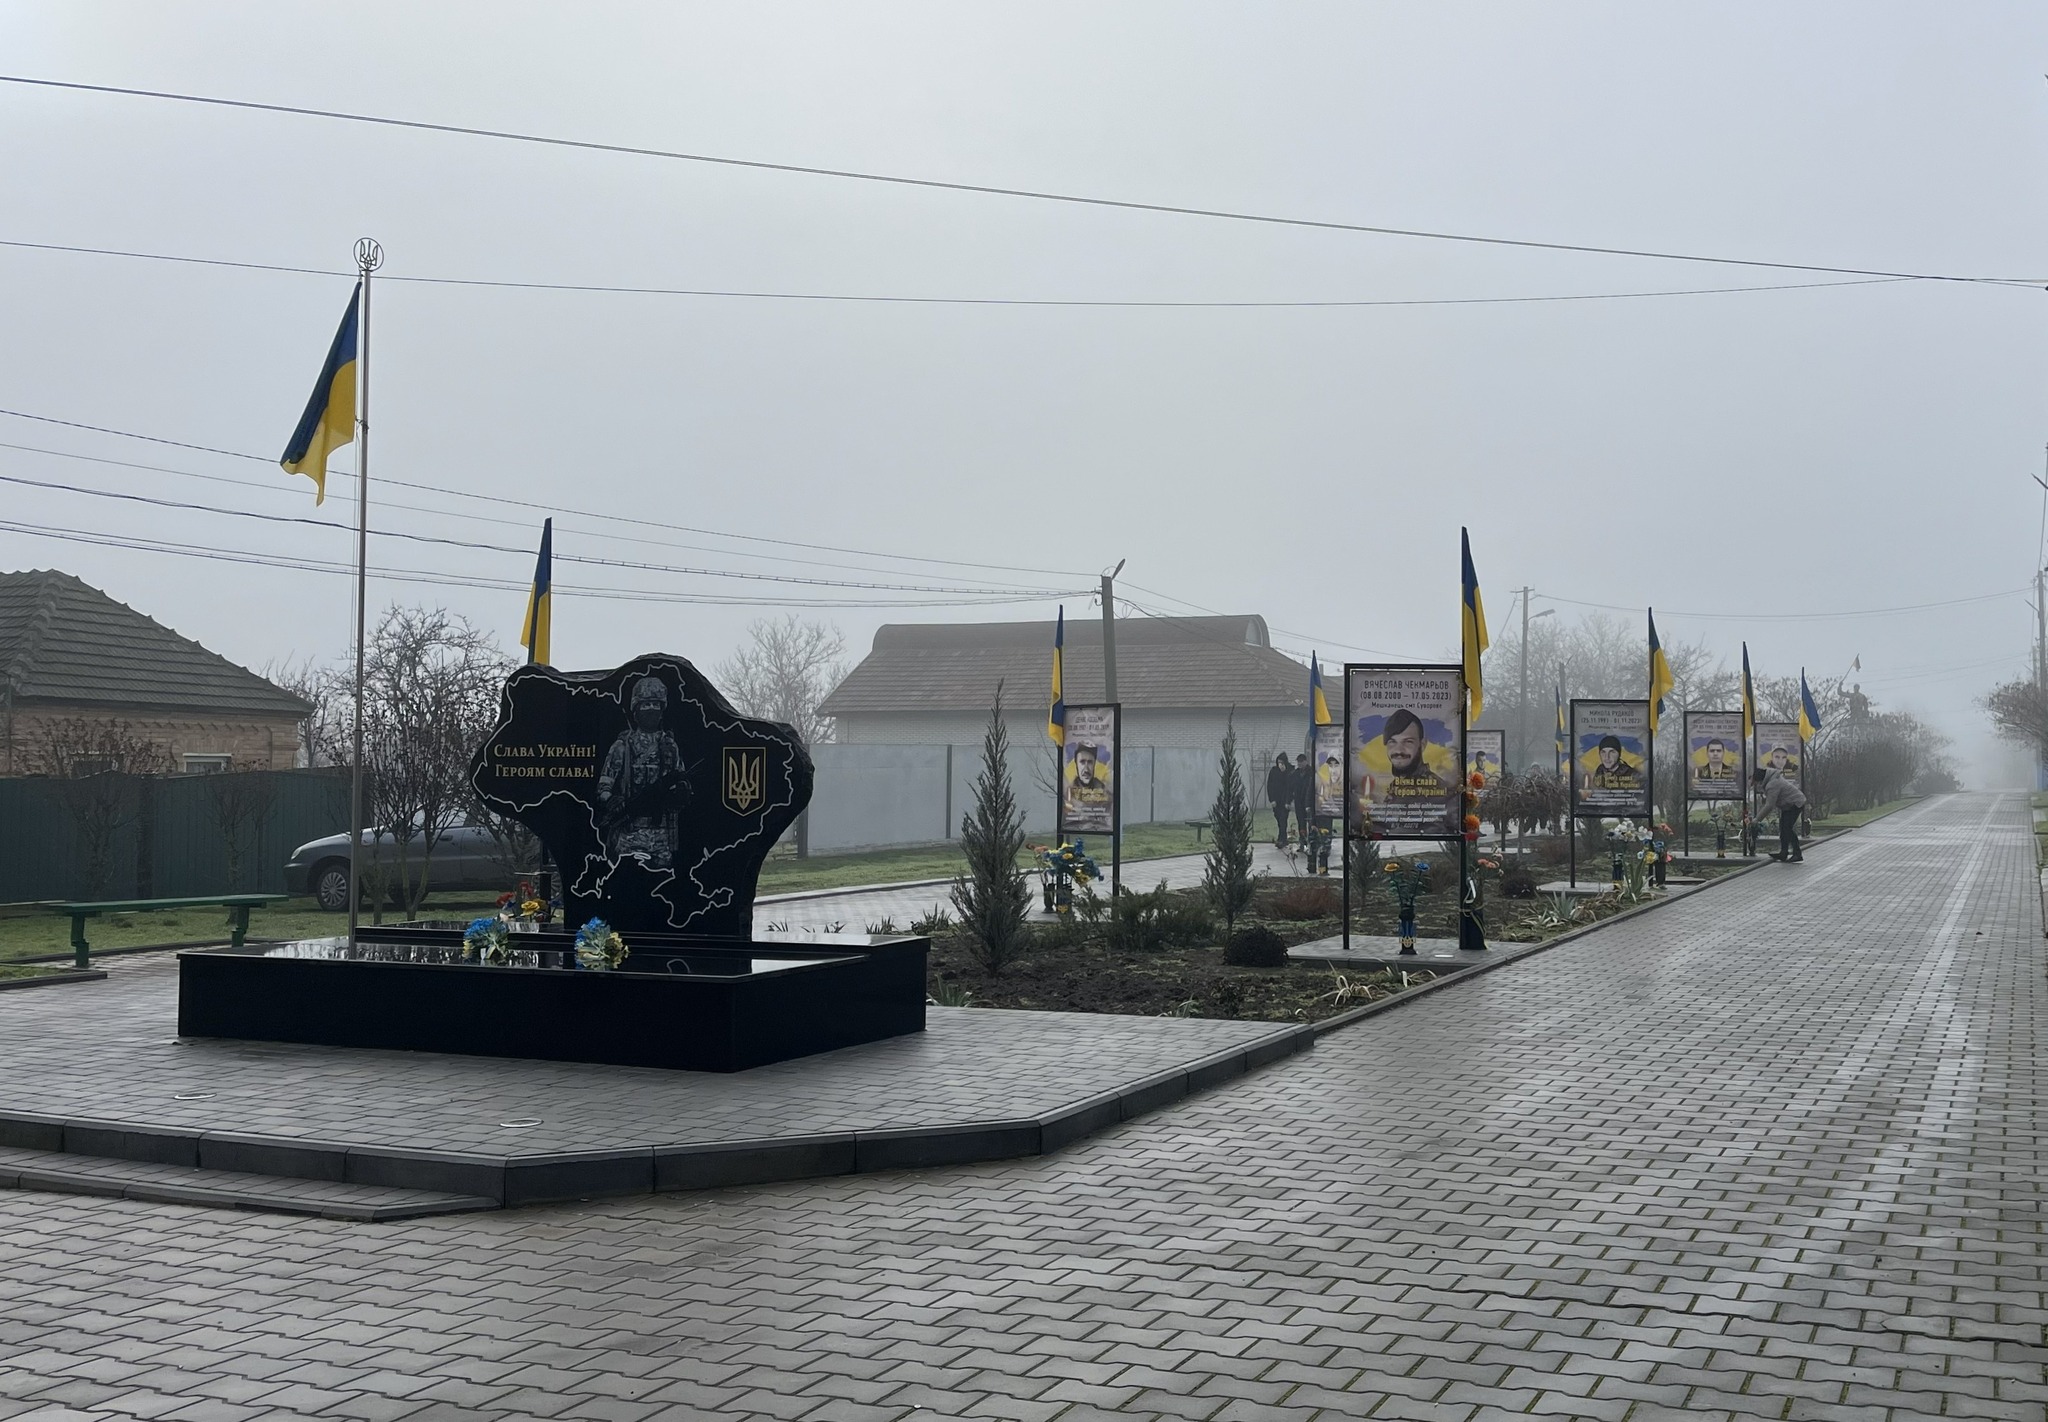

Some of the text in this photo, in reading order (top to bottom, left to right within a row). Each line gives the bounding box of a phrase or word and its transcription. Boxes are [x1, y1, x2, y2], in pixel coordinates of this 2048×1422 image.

[1364, 680, 1449, 690] ВЯЧЕСЛАВ ЧЕКМАРЬОВ
[1411, 691, 1451, 700] 17.05.2023)
[1394, 776, 1437, 786] Вічна слава
[1394, 786, 1447, 797] Герою України!
